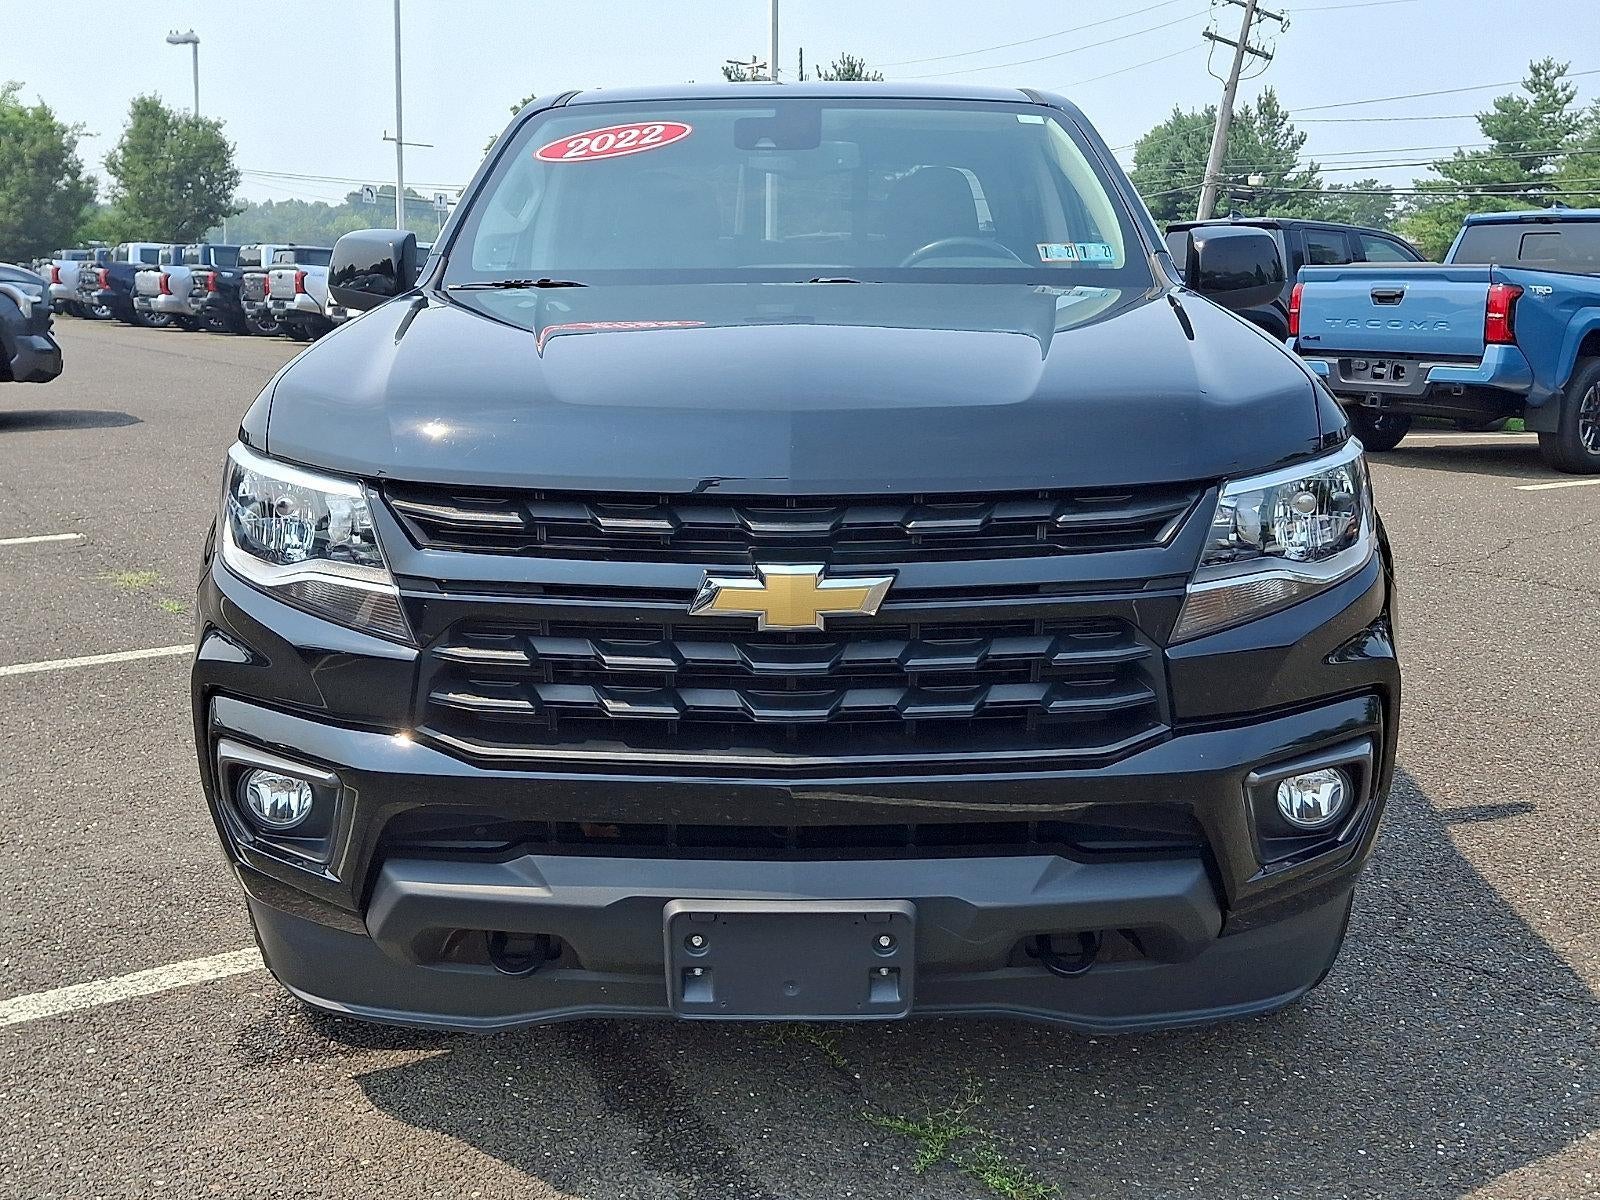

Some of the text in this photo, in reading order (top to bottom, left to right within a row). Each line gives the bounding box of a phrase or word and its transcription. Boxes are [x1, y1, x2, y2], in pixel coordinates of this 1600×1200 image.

[562, 124, 666, 159] 2022
[1528, 285, 1553, 295] TRD
[1324, 318, 1451, 331] TACOMA
